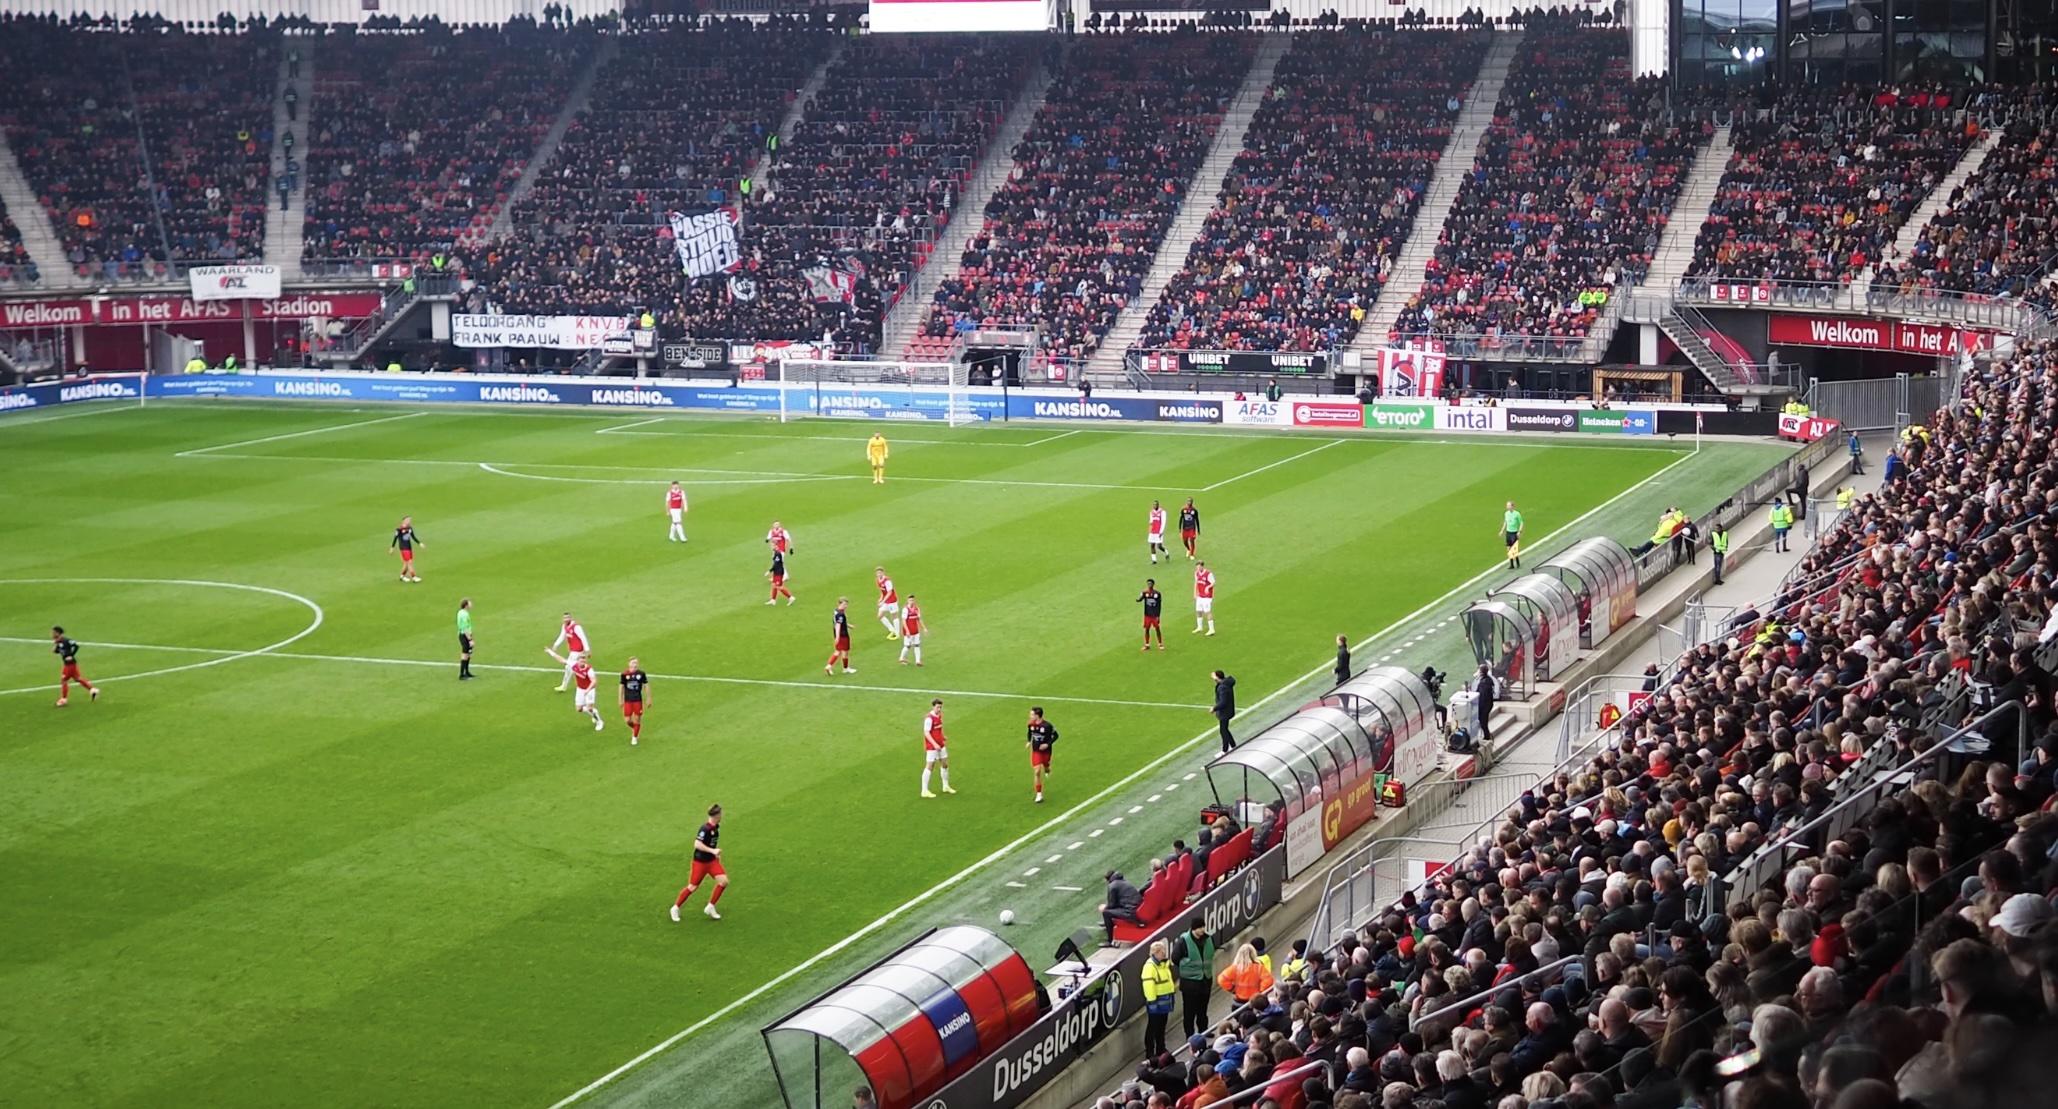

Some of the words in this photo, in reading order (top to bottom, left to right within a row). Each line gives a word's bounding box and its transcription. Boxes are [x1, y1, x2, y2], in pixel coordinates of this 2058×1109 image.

[196, 266, 275, 276] WAARLAND
[225, 276, 248, 288] AZ
[5, 303, 81, 324] Welkom
[112, 301, 131, 320] in
[139, 300, 171, 319] het
[180, 300, 230, 318] AFAS
[262, 295, 332, 315] Stadion
[455, 315, 547, 329] TELOORGANG
[576, 316, 625, 330] KNVB
[454, 332, 502, 345] FRANK
[508, 333, 560, 345] PAAUW
[1811, 320, 1879, 344] Welkom
[1902, 326, 1914, 347] in
[1920, 328, 1943, 350] het
[1947, 331, 1985, 352] AS
[1188, 353, 1231, 365] UNIBET
[1271, 355, 1314, 367] UNIBET
[1159, 404, 1220, 419] KANSINO
[1238, 403, 1278, 416] AFAS
[1241, 414, 1275, 424] software
[1448, 409, 1493, 428] intal
[1510, 414, 1561, 426] Dusseldorp
[1582, 417, 1621, 426] Heineken
[1810, 421, 1824, 437] AZ
[938, 1011, 971, 1040] KANSINO
[993, 999, 1099, 1102] Dusseldorp
